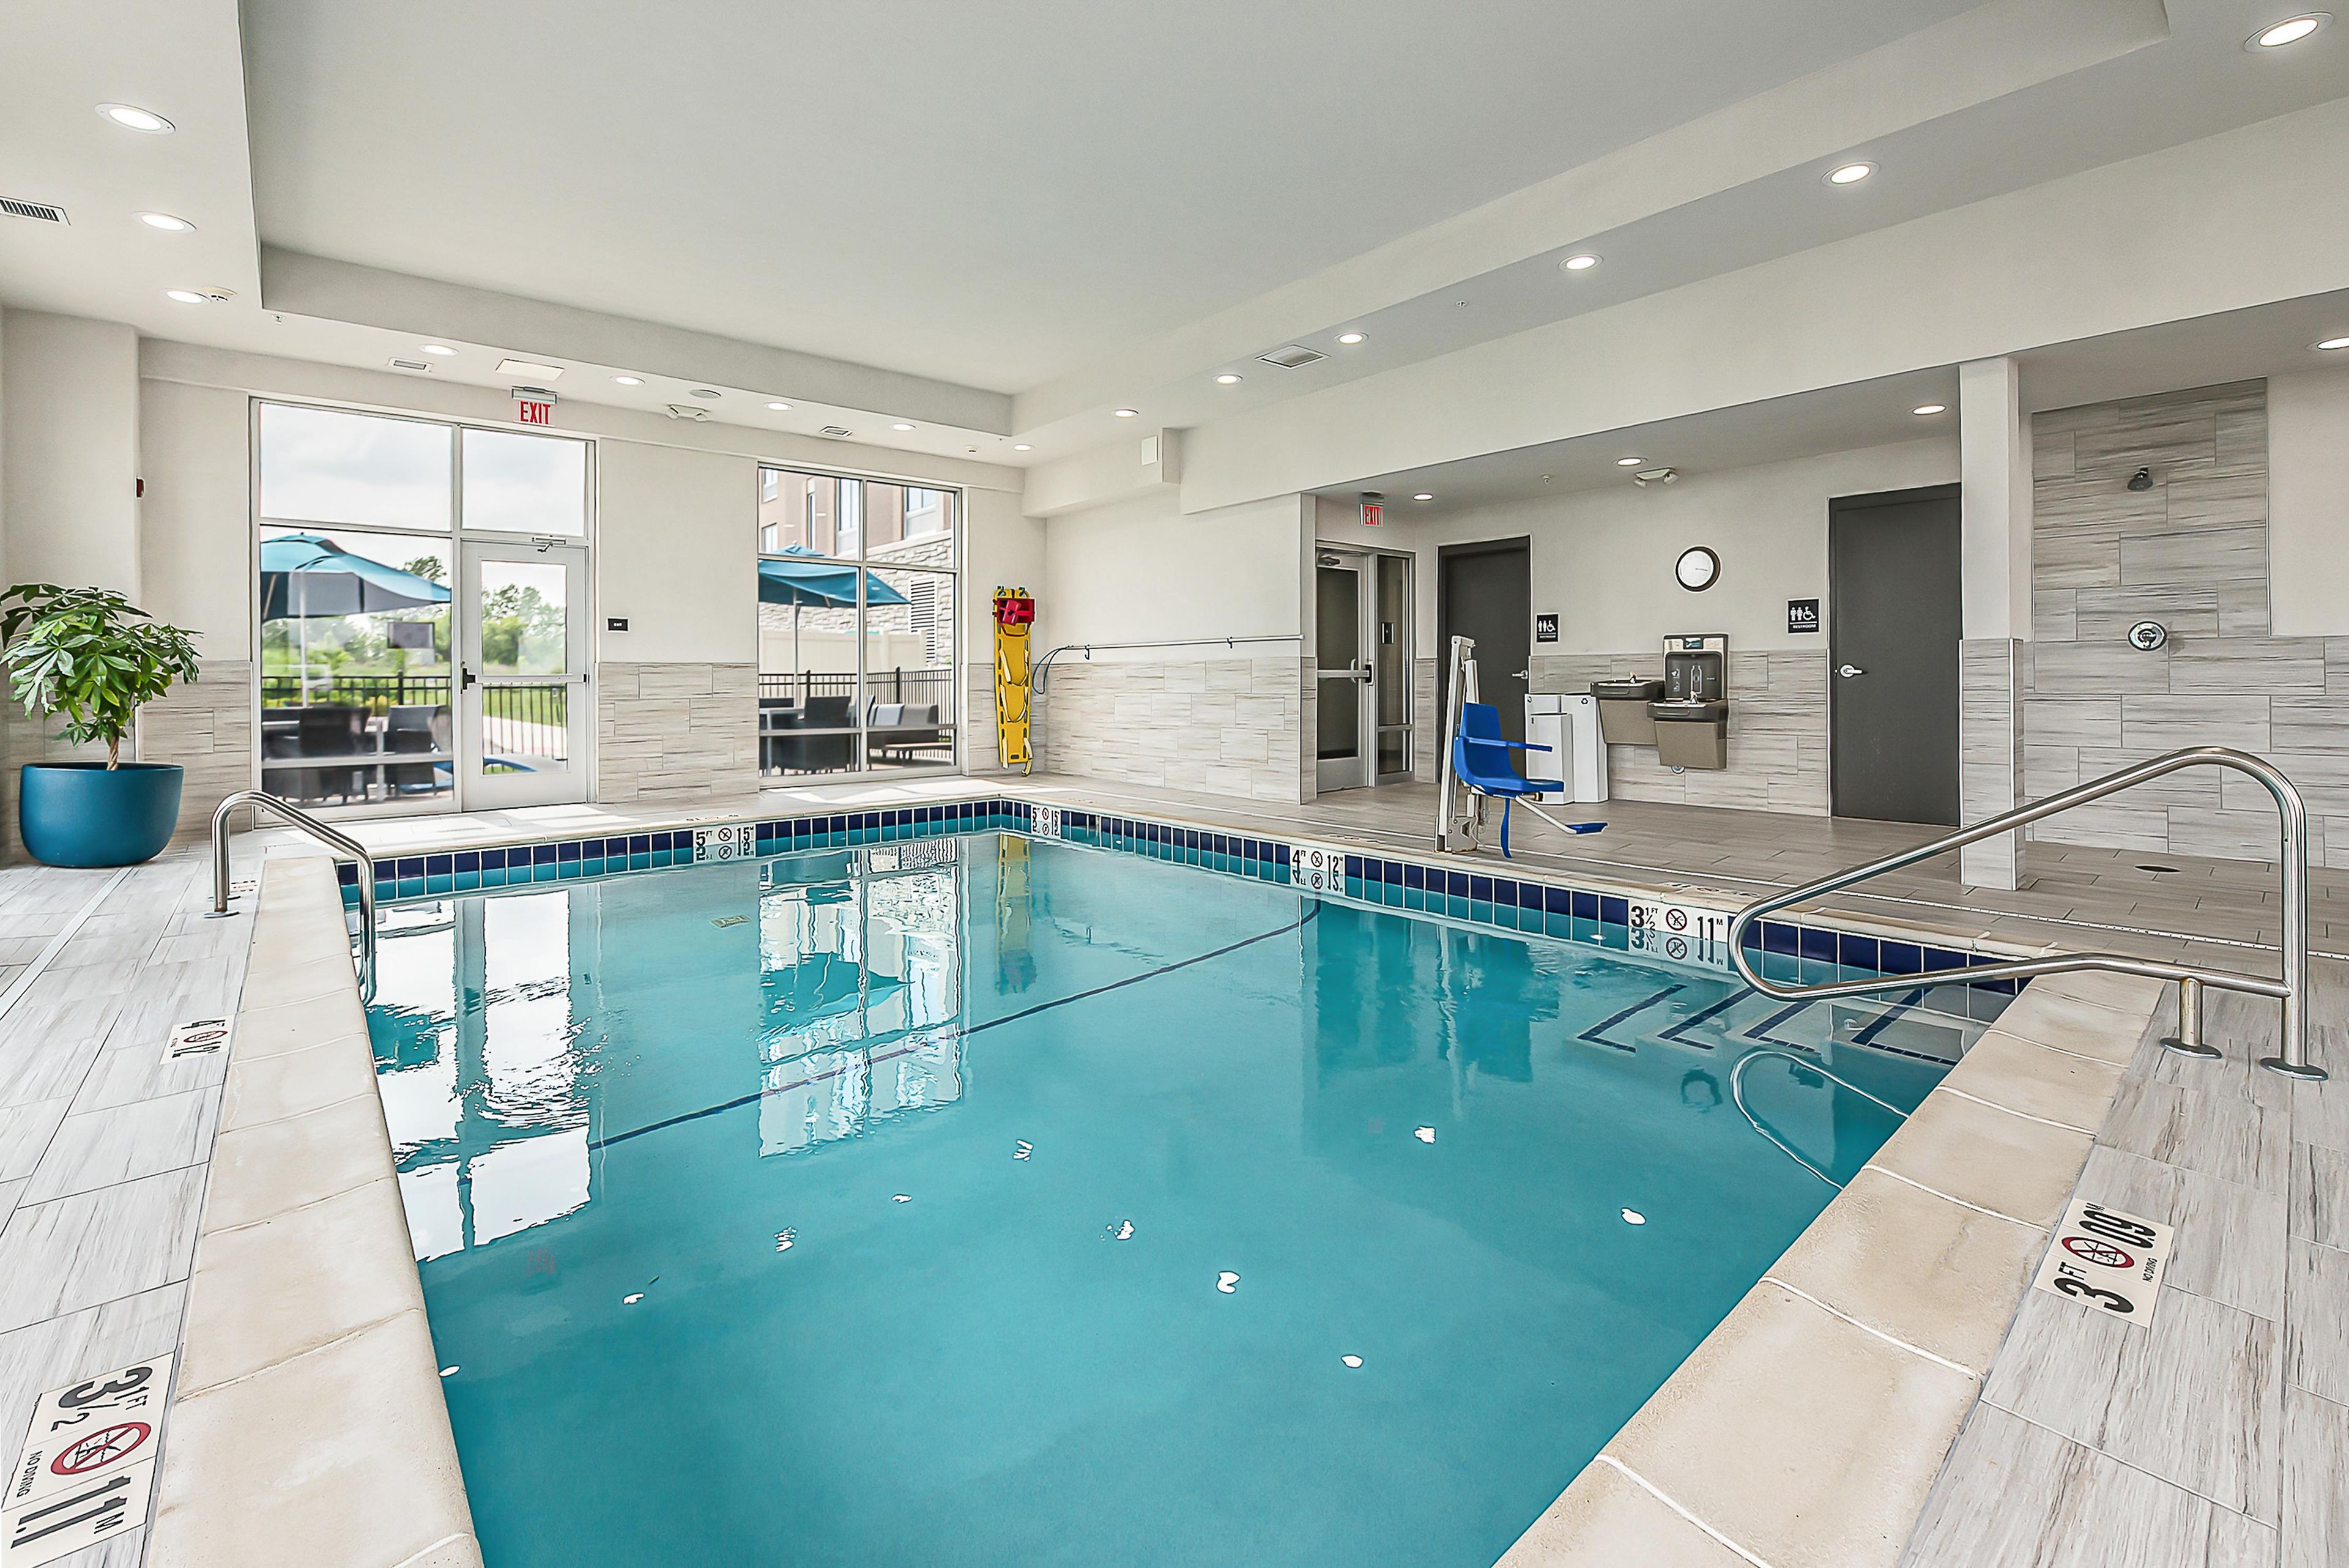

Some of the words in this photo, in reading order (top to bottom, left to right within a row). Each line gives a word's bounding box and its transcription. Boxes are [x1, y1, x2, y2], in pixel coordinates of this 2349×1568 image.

[520, 401, 551, 425] EXIT
[1365, 504, 1380, 526] EXIT
[696, 831, 706, 846] 5
[1292, 849, 1301, 866] 4
[1631, 905, 1645, 928] 3
[1716, 918, 1724, 926] M
[2058, 1261, 2088, 1281] FT
[2142, 1273, 2153, 1283] NO
[2053, 1277, 2135, 1313] 3
[58, 1367, 153, 1408] 3
[125, 1394, 149, 1411] FT
[28, 1451, 43, 1466] NO
[16, 1465, 38, 1498] DIVING
[93, 1511, 125, 1534] M
